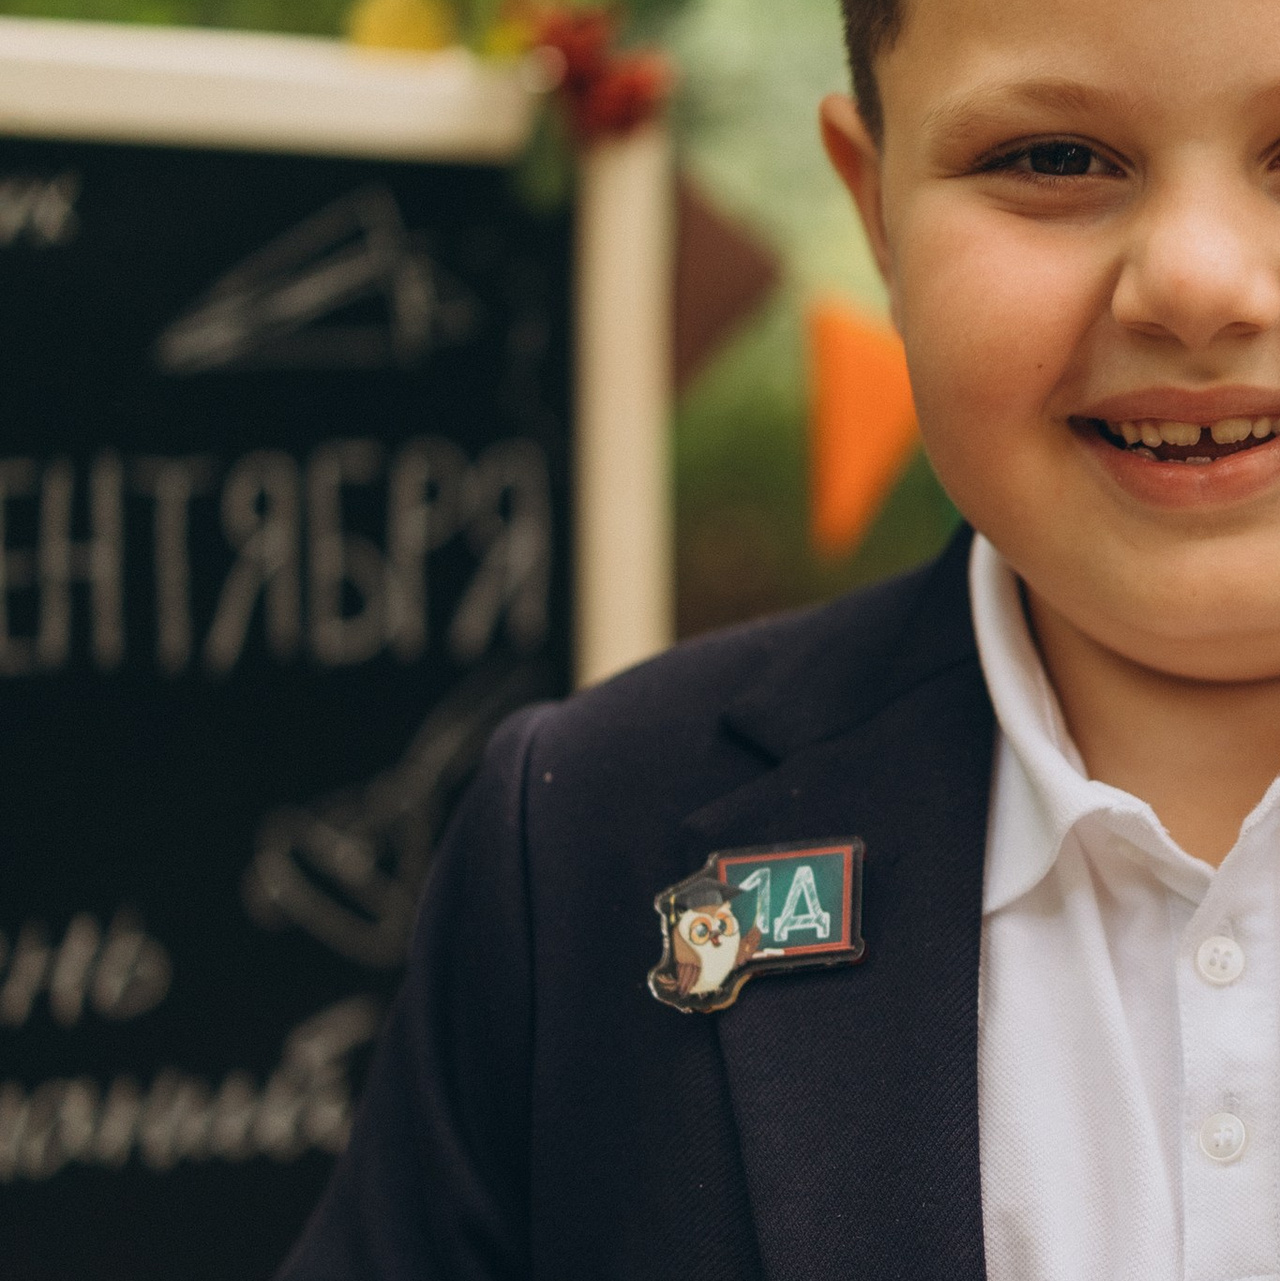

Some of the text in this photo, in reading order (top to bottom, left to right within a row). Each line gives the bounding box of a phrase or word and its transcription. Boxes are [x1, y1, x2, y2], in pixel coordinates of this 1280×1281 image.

[0, 438, 552, 674] ЕНТЯБРЯ
[738, 865, 831, 942] 1Д
[0, 908, 172, 1027] нь
